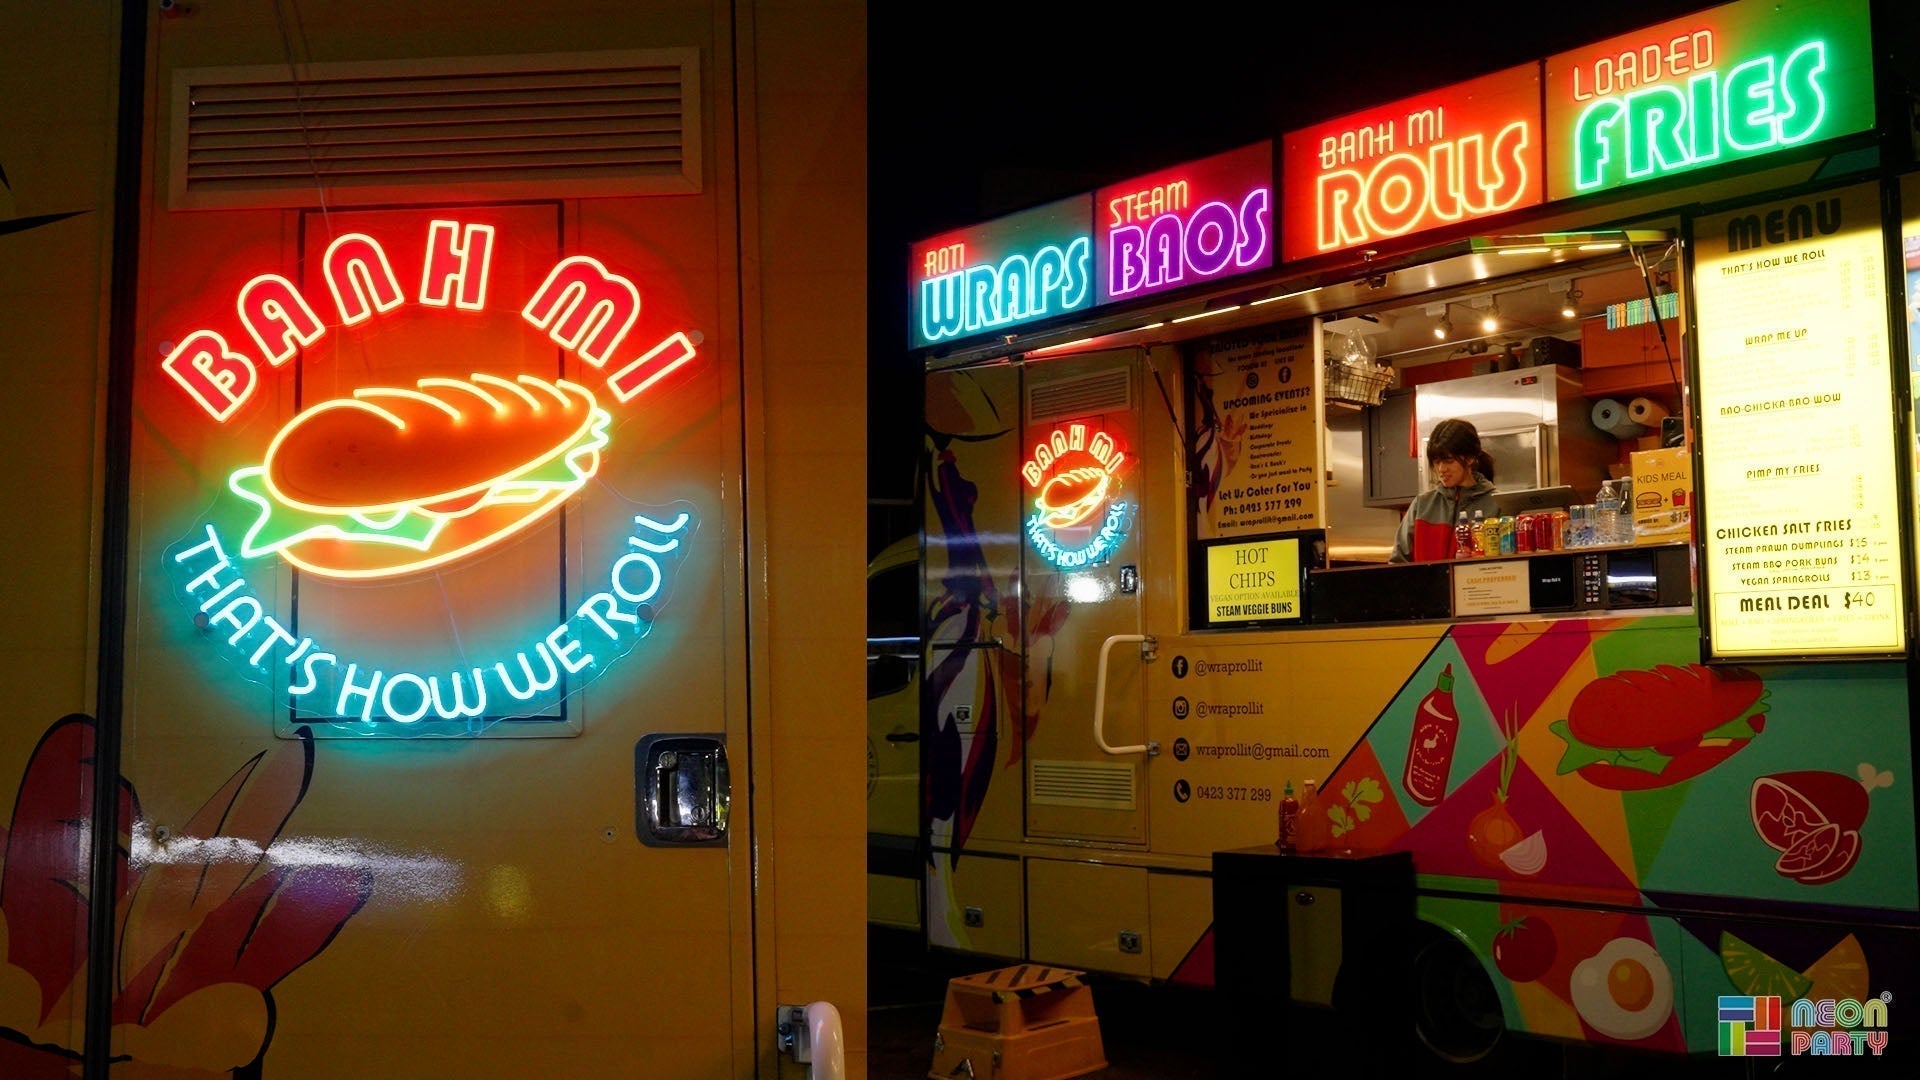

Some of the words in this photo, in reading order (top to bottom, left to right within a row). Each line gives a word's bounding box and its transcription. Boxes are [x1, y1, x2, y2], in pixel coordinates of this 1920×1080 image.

[1573, 30, 1714, 102] LOADED
[1574, 40, 1826, 190] FRIES
[1318, 119, 1396, 171] BANH
[1407, 106, 1444, 148] MI
[1317, 120, 1528, 250] ROLLS
[1109, 180, 1188, 229] STEAM
[1727, 198, 1842, 253] MENU
[1108, 187, 1268, 297] BAOS
[923, 243, 966, 278] ROTI
[1721, 263, 1753, 276] THAT'S
[1756, 257, 1781, 269] HOW
[1784, 254, 1799, 264] WE
[1802, 249, 1826, 260] ROLL
[921, 236, 1091, 341] WRAPS
[161, 219, 496, 423] BANH
[521, 255, 697, 404] MI
[1745, 333, 1774, 346] WRAP
[1777, 330, 1792, 341] ME
[1794, 328, 1808, 338] UP
[1223, 393, 1272, 410] UPCOMING
[1274, 386, 1311, 401] EVENTS?
[1813, 392, 1842, 404] WOW
[1022, 424, 1086, 488] BANH
[1088, 431, 1125, 475] MI
[1637, 474, 1660, 485] KIDS
[1661, 471, 1688, 482] MEAL
[1746, 468, 1773, 479] PIMP
[1775, 466, 1790, 477] MY
[1793, 463, 1820, 475] FRIES
[1218, 490, 1232, 501] Let
[1234, 488, 1244, 499] Us
[1246, 486, 1274, 498] Cater
[1276, 483, 1291, 494] For
[1293, 481, 1311, 492] You
[1223, 505, 1238, 516] Ph:
[1239, 502, 1261, 514] 0423
[1264, 499, 1282, 511] 377
[1284, 498, 1302, 509] 299
[1218, 520, 1238, 529] Email:
[1716, 523, 1778, 540] CHICKEN
[1783, 521, 1811, 535] SALT
[1816, 518, 1852, 532] FRIES
[1057, 549, 1087, 567] HOW
[1085, 535, 1108, 560] WE
[1725, 545, 1754, 555] STEAM
[1756, 543, 1788, 553] PRAWN
[1791, 539, 1844, 551] DUMPLINGS
[1849, 537, 1869, 548] $15
[1235, 547, 1269, 566] HOT
[1732, 560, 1761, 571] STEAM
[1763, 559, 1783, 569] BBQ
[1785, 558, 1812, 568] PORK
[1815, 556, 1838, 566] BUNS
[1850, 554, 1871, 566] $14
[1229, 571, 1275, 590] CHIPS
[1741, 576, 1769, 586] VEGAN
[1772, 573, 1831, 585] SPRINGROLLS
[1851, 570, 1872, 582] $13
[1210, 594, 1234, 603] VEGAN
[1233, 592, 1260, 601] OPTION
[1261, 589, 1299, 600] AVAILABLE
[1739, 595, 1783, 613] MEAL
[1788, 593, 1830, 610] DEAL
[1844, 590, 1876, 610] $40
[174, 523, 338, 697] THAT'S
[335, 662, 488, 725] HOW
[495, 624, 596, 700] WE
[577, 512, 690, 640] ROLL
[1216, 604, 1242, 617] STEAM
[1242, 603, 1270, 615] VEGGIE
[1271, 601, 1293, 614] BUNS
[1195, 659, 1263, 676] @wraprollit
[1196, 701, 1264, 718] @wraprollit
[1196, 743, 1330, 760] wraprollit@gmail.com
[1197, 786, 1224, 801] 0423
[1227, 787, 1248, 801] 377
[1250, 788, 1272, 802] 299
